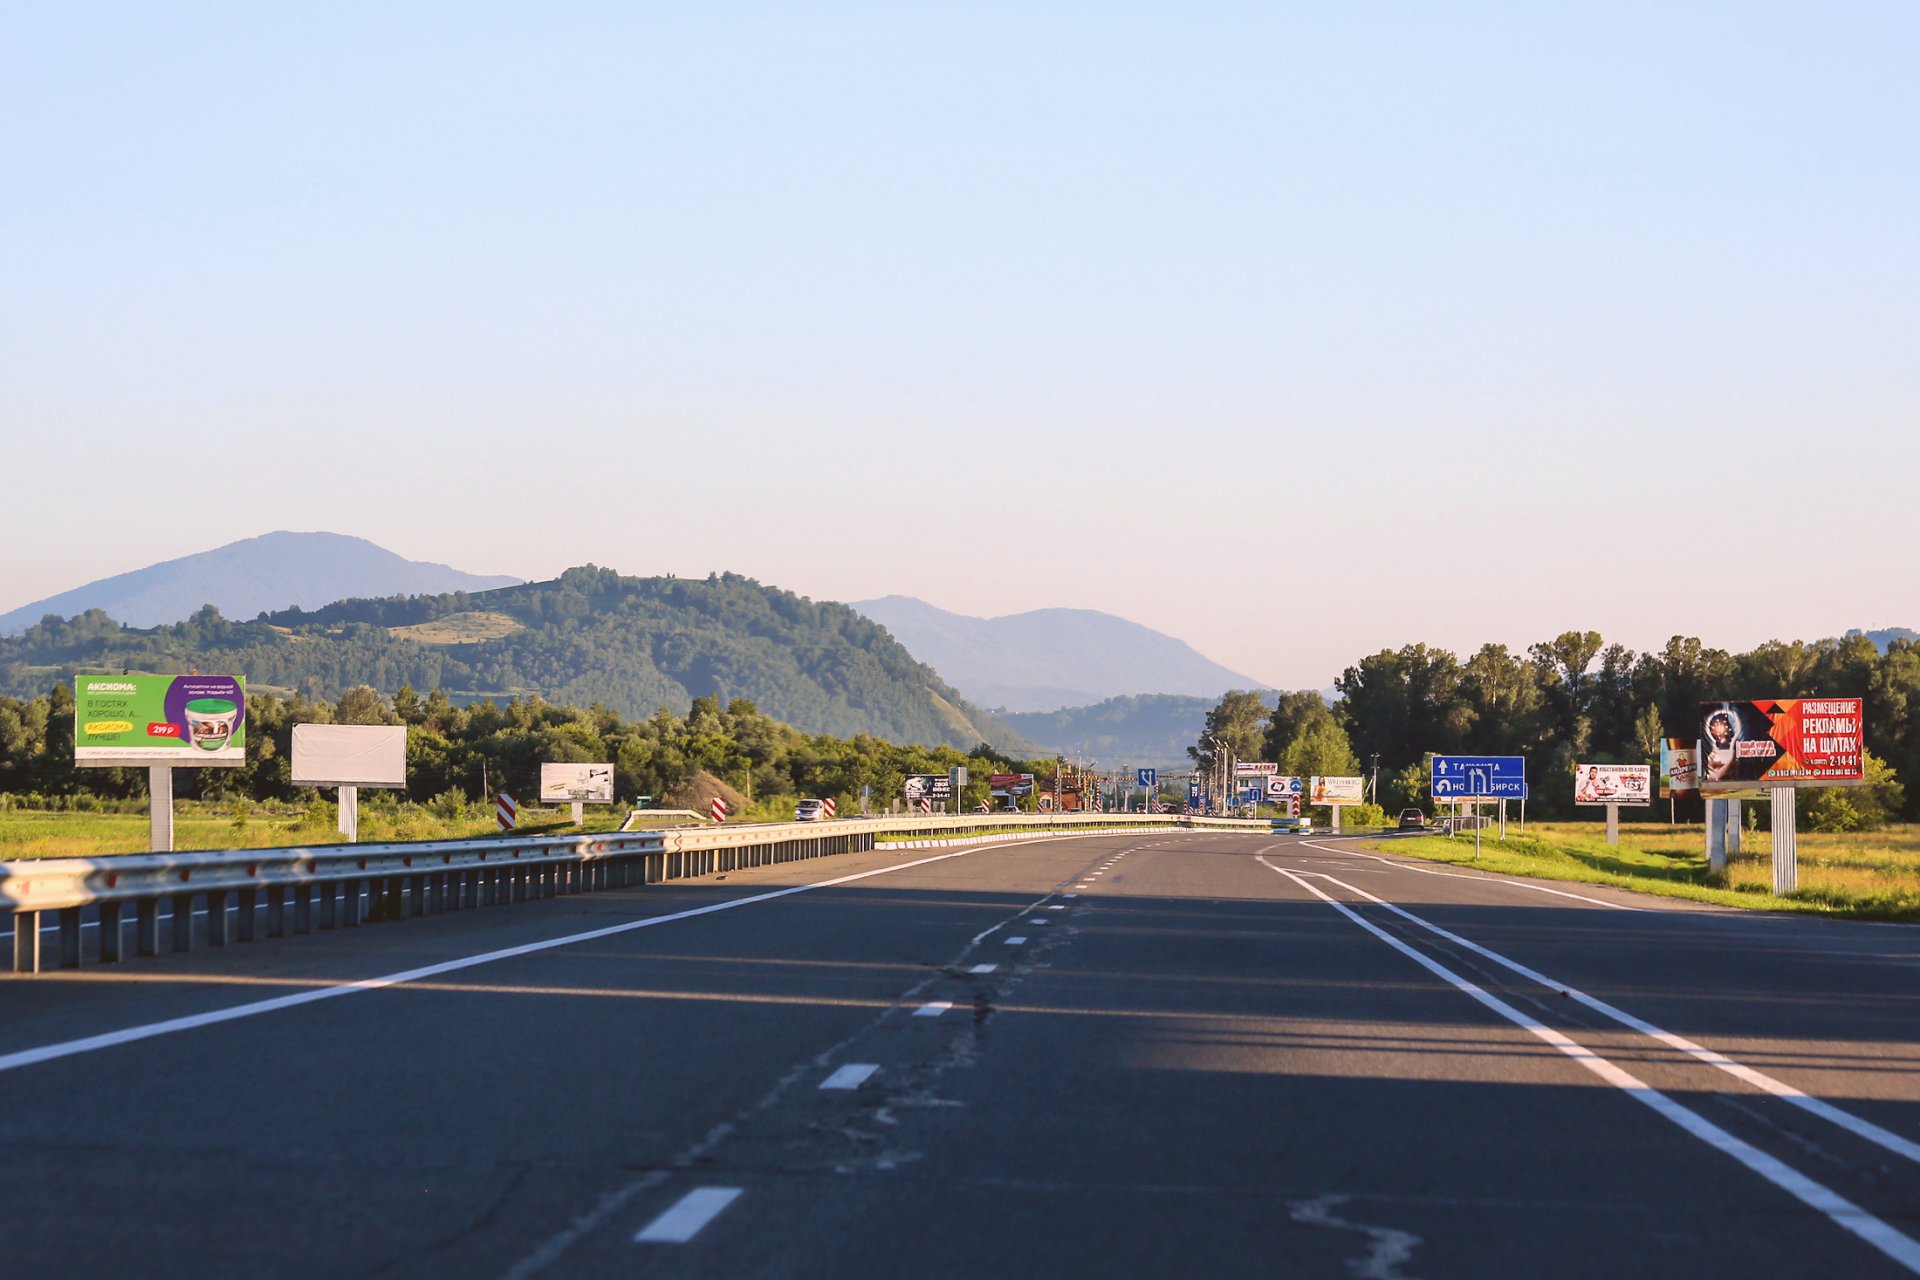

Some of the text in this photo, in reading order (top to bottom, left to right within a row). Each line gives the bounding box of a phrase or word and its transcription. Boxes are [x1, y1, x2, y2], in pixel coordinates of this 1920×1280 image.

[1802, 702, 1856, 715] РАЗМЕЩЕНИЕ
[1802, 717, 1856, 734] РЕКЛАМЫ
[1803, 737, 1857, 755] НА ЩИТАХ
[1829, 755, 1857, 767] 2-14-41
